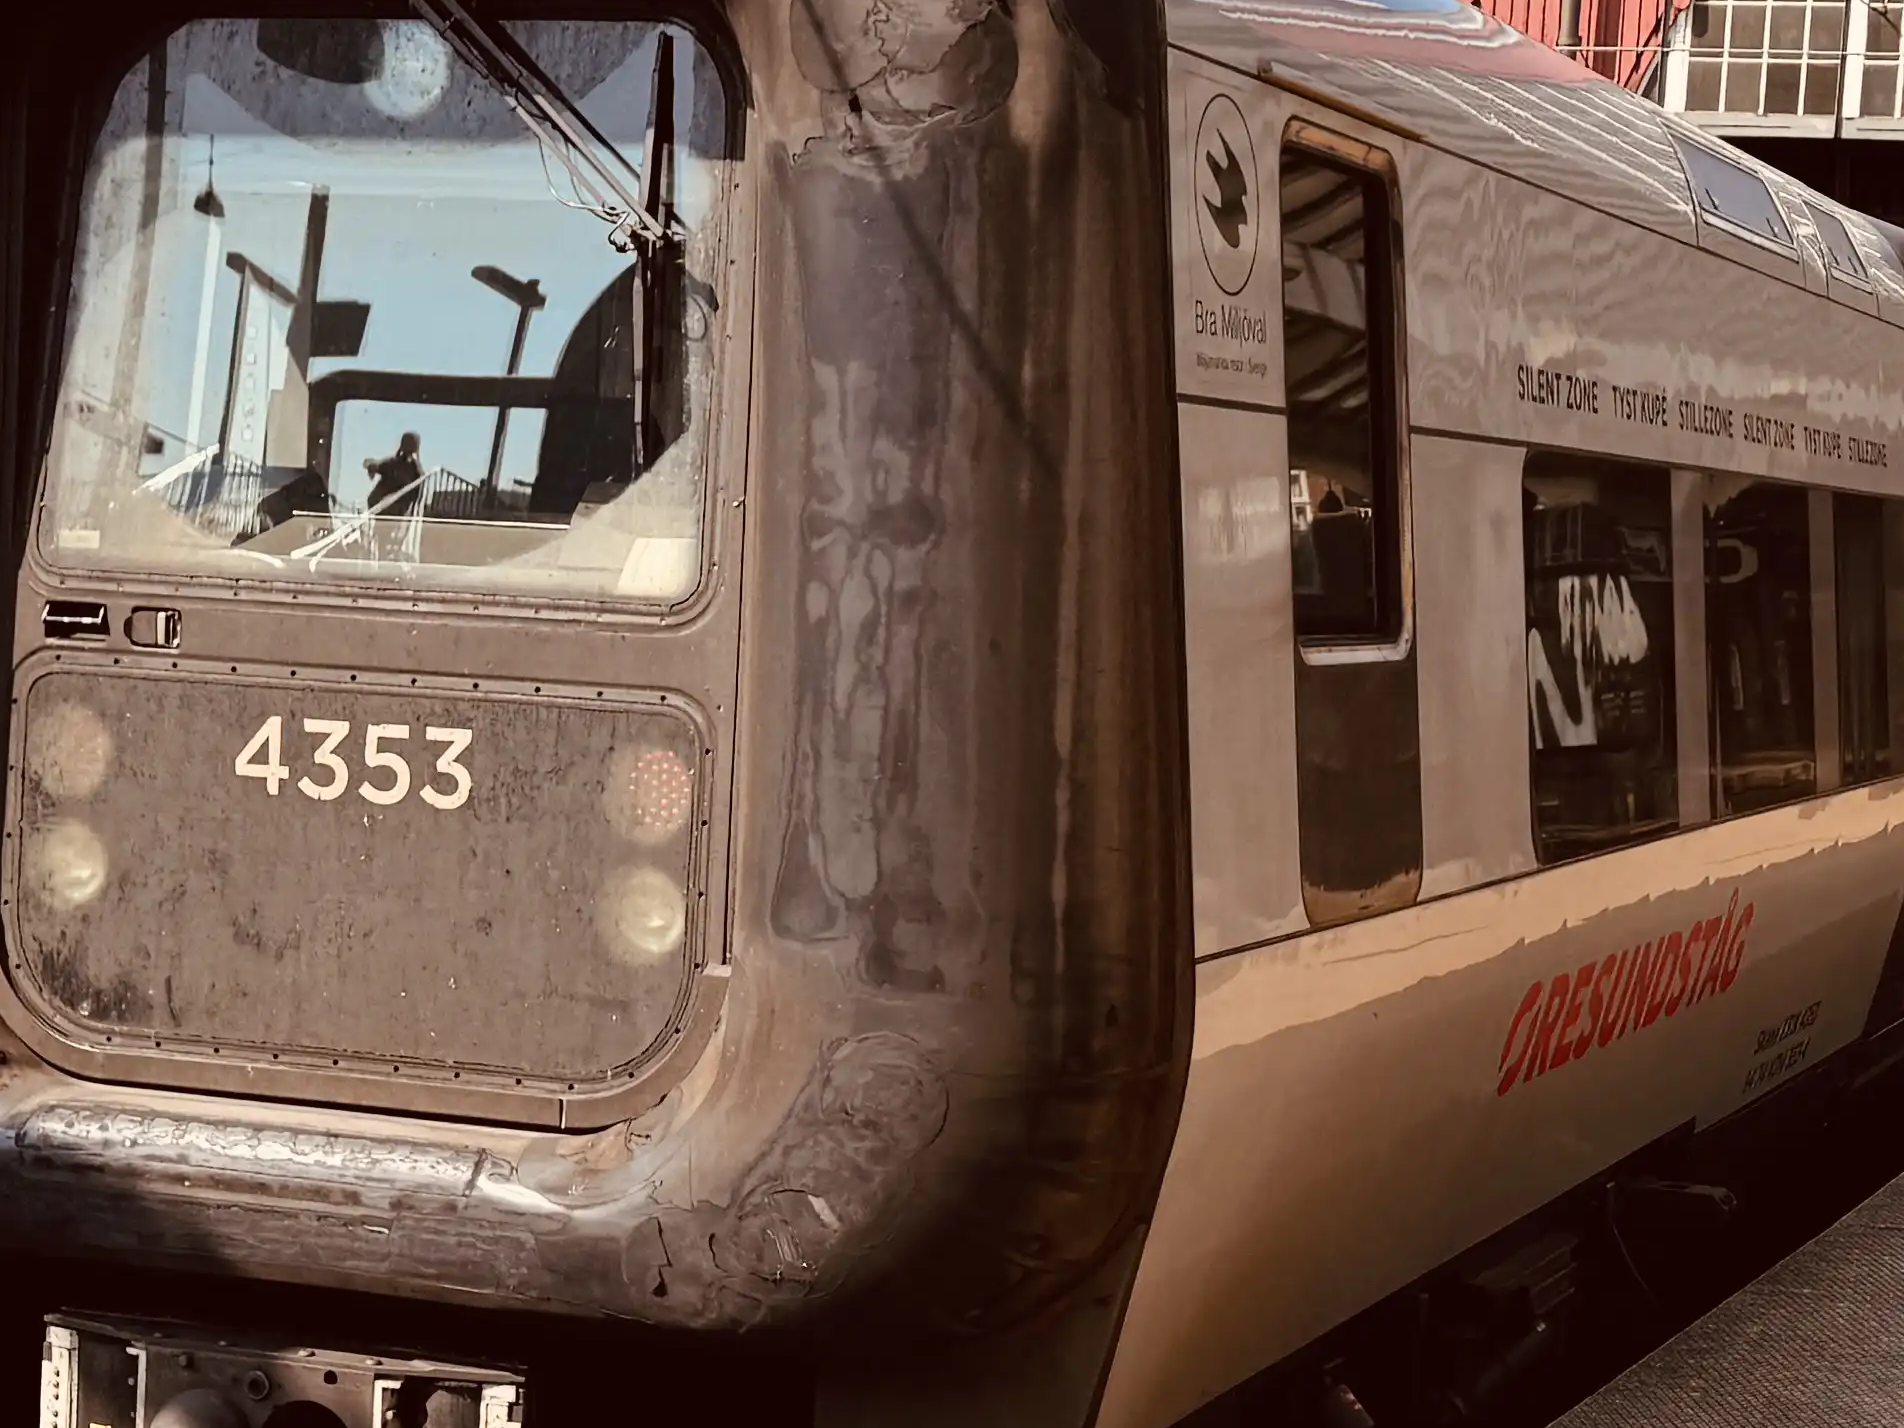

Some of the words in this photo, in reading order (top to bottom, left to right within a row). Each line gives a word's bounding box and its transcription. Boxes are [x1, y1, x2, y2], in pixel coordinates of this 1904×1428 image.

[1195, 299, 1217, 336] Bra
[1518, 364, 1562, 408] SILENT
[1566, 375, 1598, 414] ZONE
[1612, 385, 1638, 422] TYST
[1678, 400, 1733, 438] STILLEZONE
[1743, 413, 1772, 446] SILENT
[1773, 420, 1795, 451] ZONE
[235, 715, 475, 810] 4353
